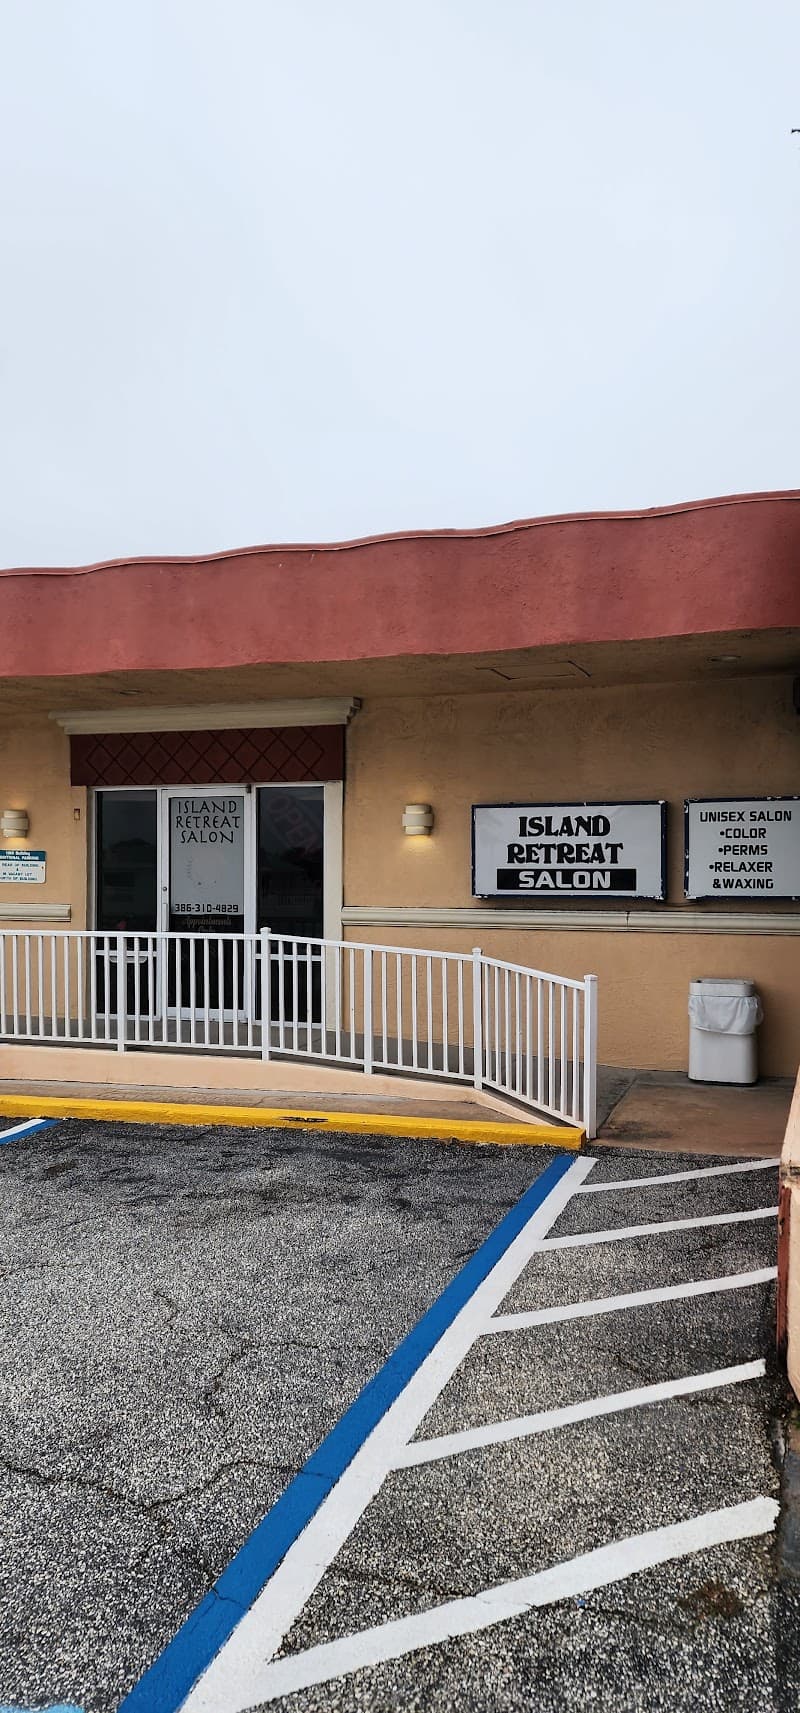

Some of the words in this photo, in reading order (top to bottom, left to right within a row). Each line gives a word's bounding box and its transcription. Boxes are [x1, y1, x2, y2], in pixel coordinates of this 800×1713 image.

[178, 800, 237, 814] ISLAND
[175, 815, 241, 829] RETREAT
[699, 811, 746, 823] UNISEX
[749, 810, 792, 822] SALON
[518, 814, 611, 838] ISLAND
[180, 830, 234, 844] SALON
[506, 842, 624, 864] RETREAT
[518, 870, 612, 889] SALON
[175, 903, 239, 913] 386-310-4829
